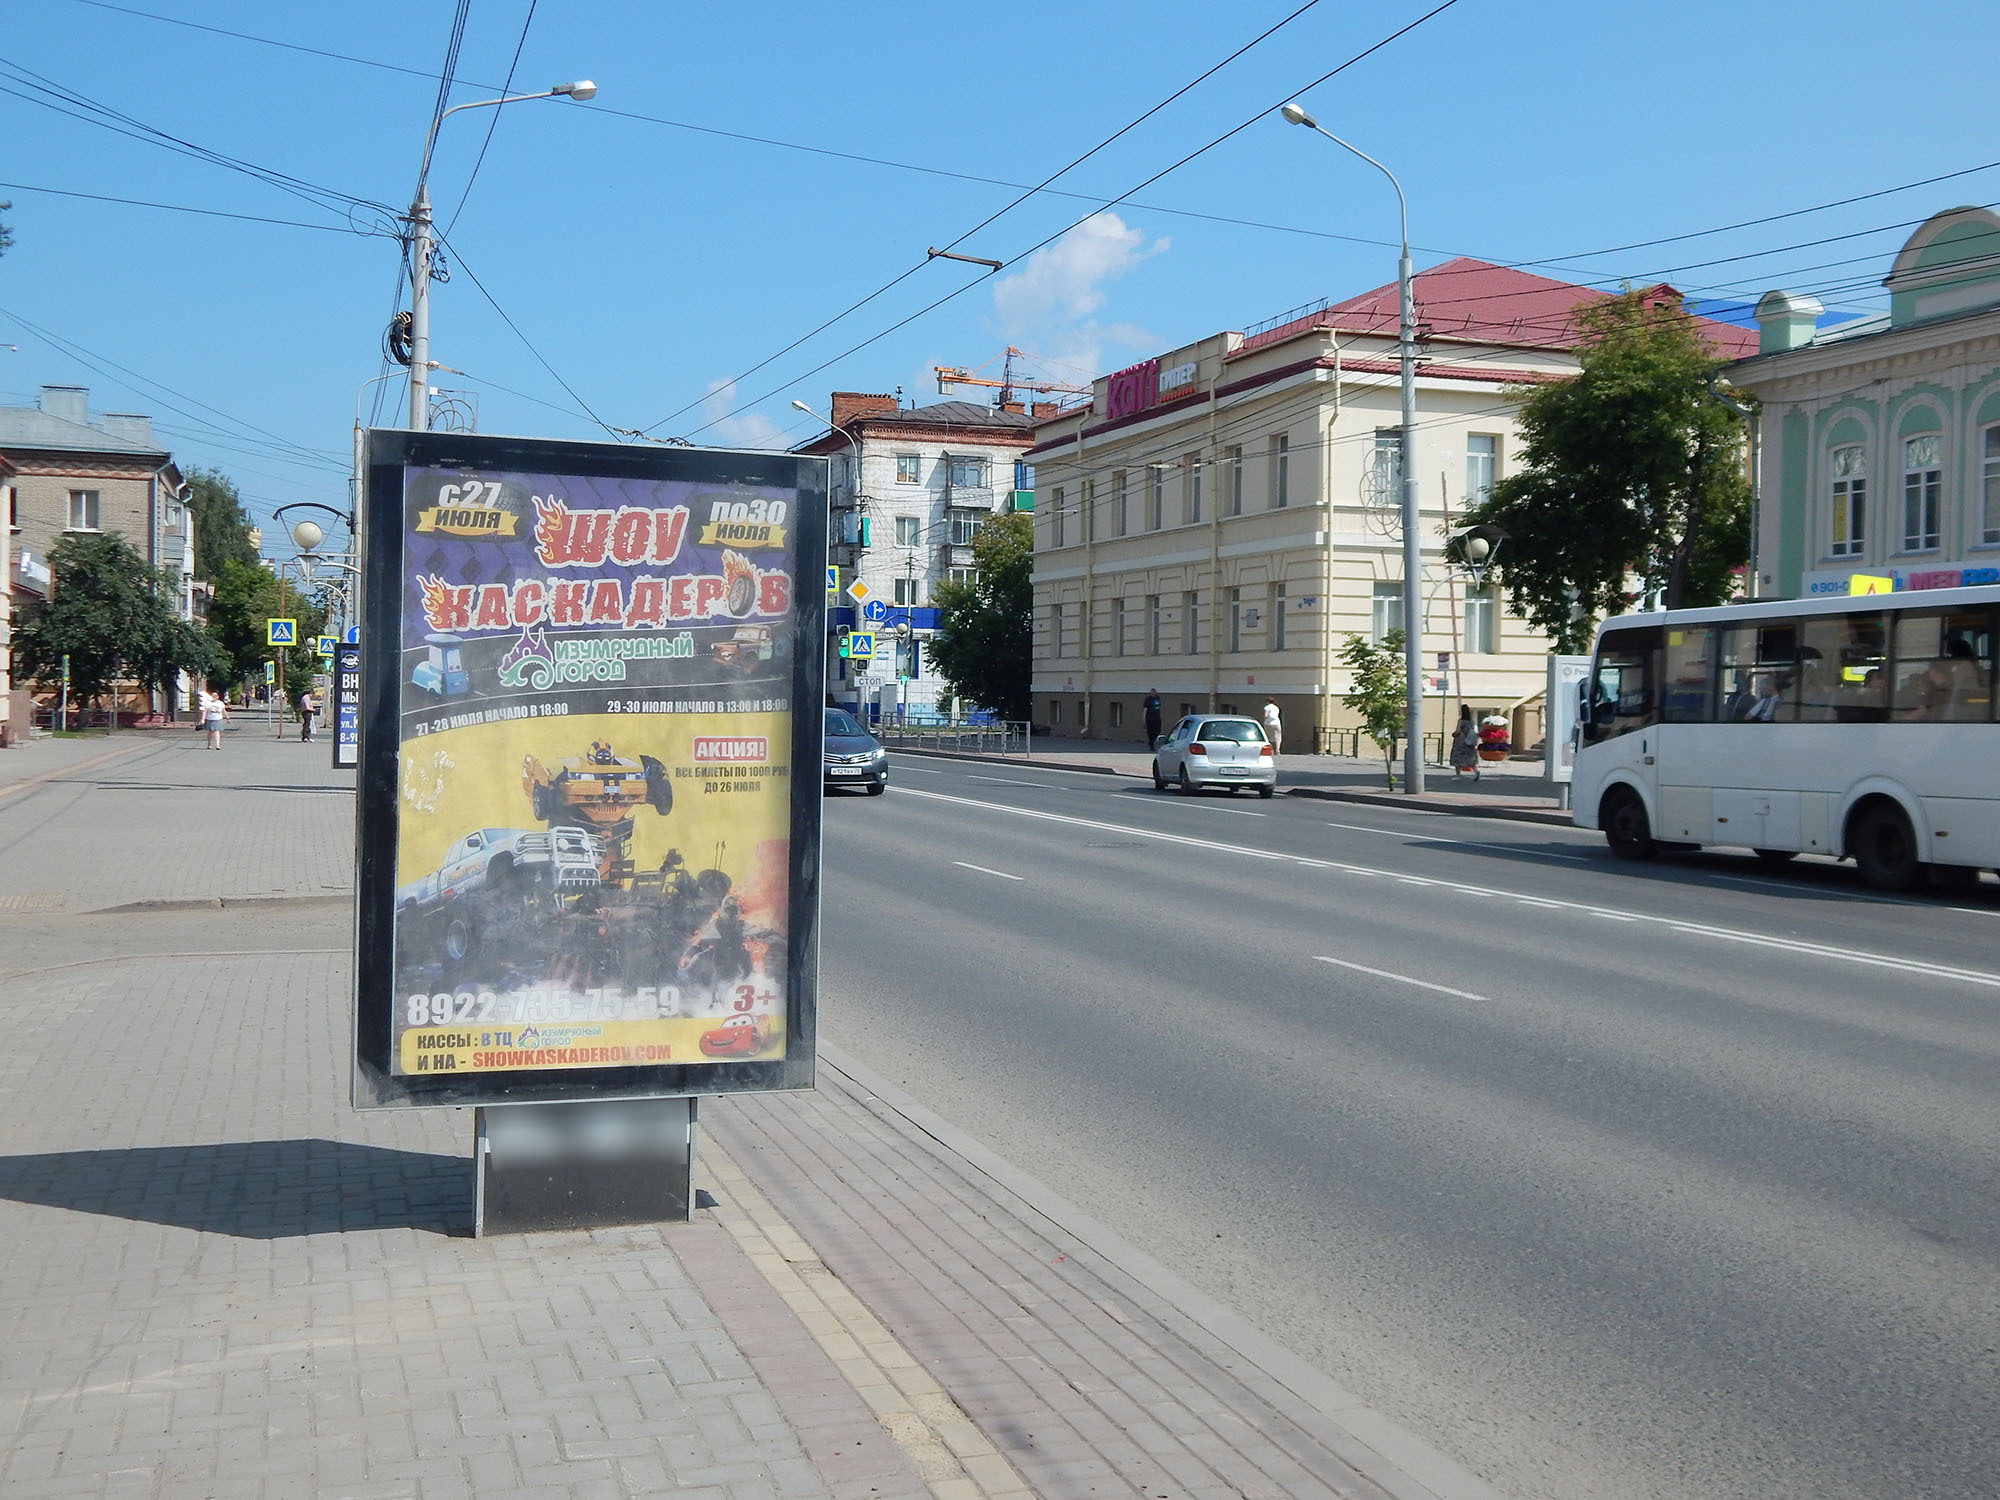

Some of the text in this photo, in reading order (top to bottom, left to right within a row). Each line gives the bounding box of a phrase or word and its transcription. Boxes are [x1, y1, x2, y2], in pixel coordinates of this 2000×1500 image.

[1107, 358, 1158, 419] kari
[1159, 362, 1197, 393] ГИПЕР
[435, 509, 501, 529] ИЮЛЯ
[715, 523, 771, 541] ИЮЛЯ
[554, 631, 694, 661] ИЗУМРУДНЫЙ
[555, 660, 626, 683] ГОРОД
[450, 711, 484, 729] ИЮЛЯ
[484, 705, 529, 722] НАЧАЛО
[530, 704, 538, 717] В
[539, 702, 569, 716] 18:00
[642, 700, 674, 713] ИЮЛЯ
[675, 700, 715, 713] НАЧАЛО
[718, 700, 725, 713] В
[726, 700, 751, 712] 13:00
[753, 700, 760, 711] И
[696, 741, 765, 760] АКЦИЯ!
[675, 766, 693, 778] ВСЕ
[695, 766, 733, 778] БИЛЕТЫ
[734, 766, 747, 777] ПО
[749, 766, 771, 777] 1000
[704, 781, 761, 795] ДО 26 ИЮЛЯ
[407, 985, 680, 1026] 8922-735-75-59
[733, 984, 777, 1012] 3+
[481, 1034, 492, 1047] В
[494, 1032, 513, 1047] ТЦ
[417, 1055, 429, 1070] И
[433, 1054, 456, 1070] НА
[473, 1045, 672, 1067] SHOWKASKADEROV.COM
